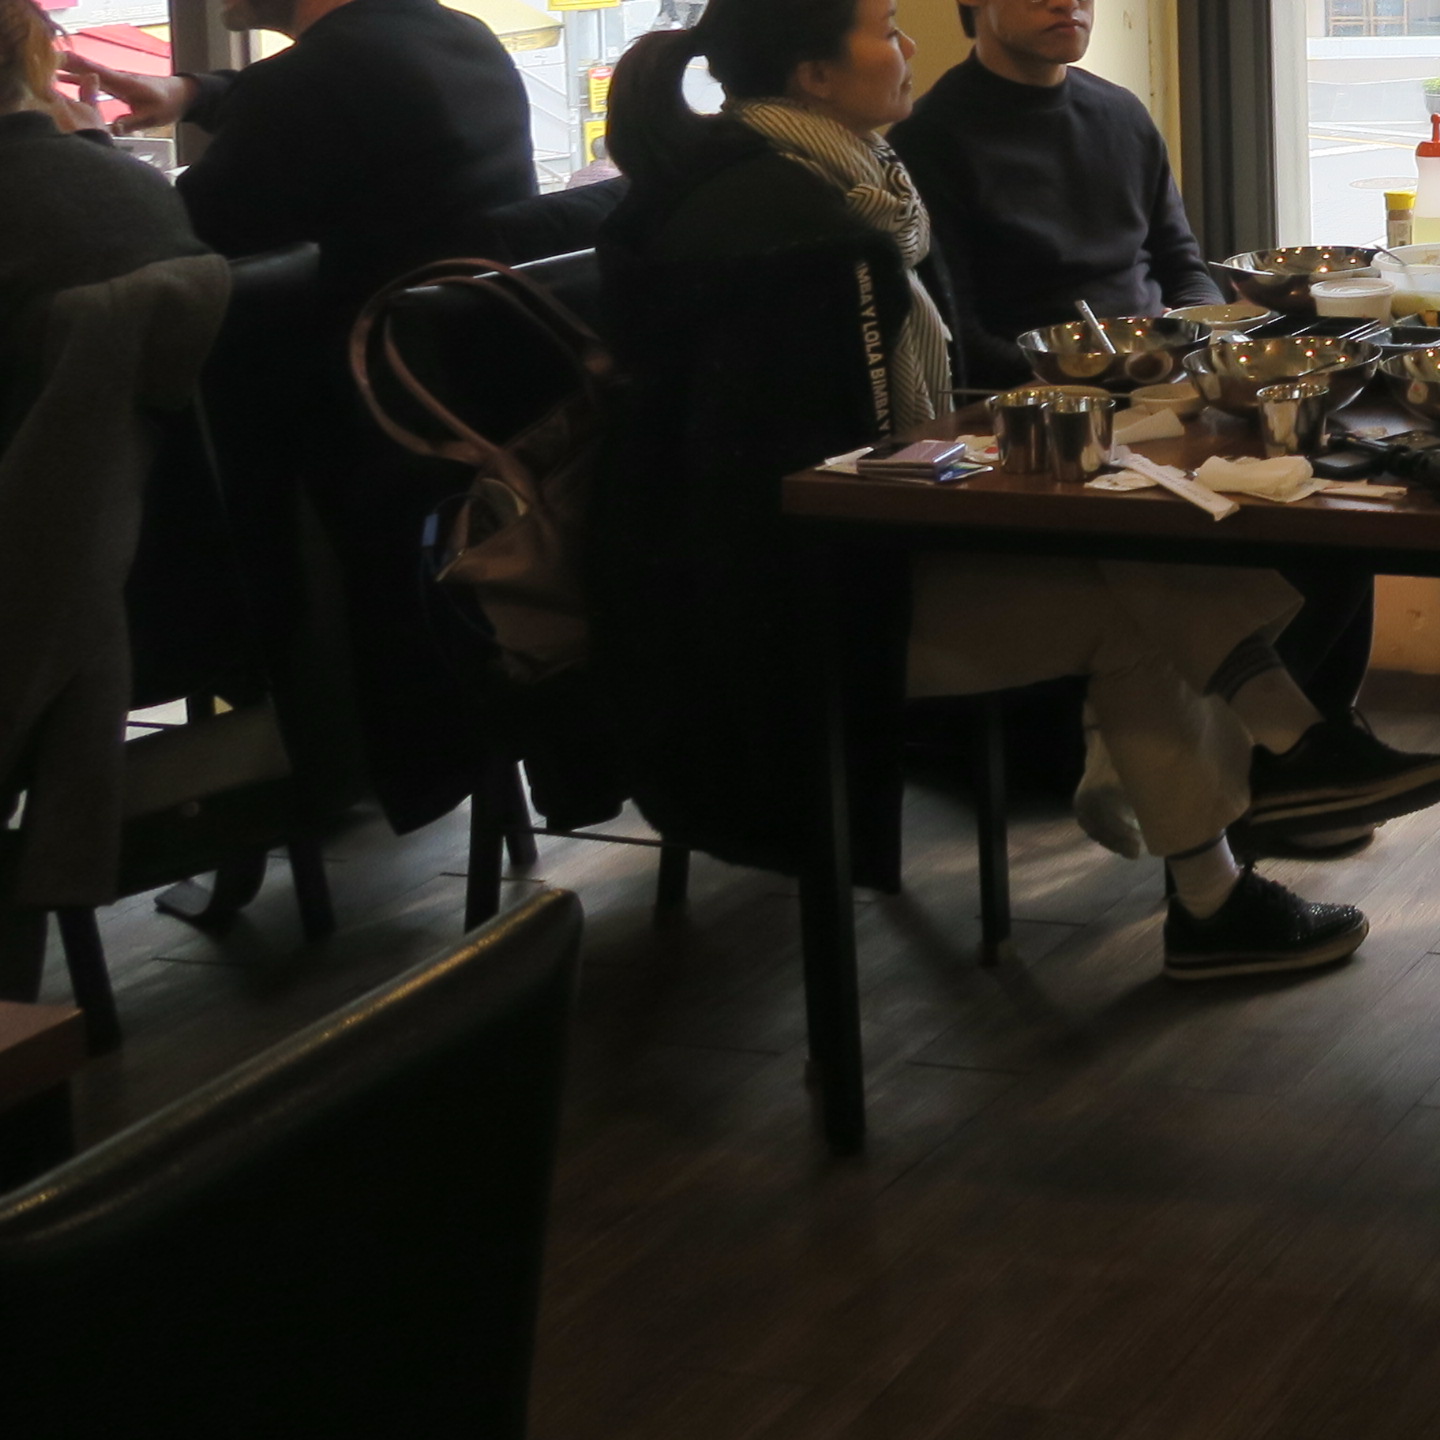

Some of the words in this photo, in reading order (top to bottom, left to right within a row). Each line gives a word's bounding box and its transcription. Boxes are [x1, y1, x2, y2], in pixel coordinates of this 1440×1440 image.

[855, 261, 873, 306] IMBA
[862, 321, 884, 365] LOLA
[871, 367, 889, 420] BIMBA
